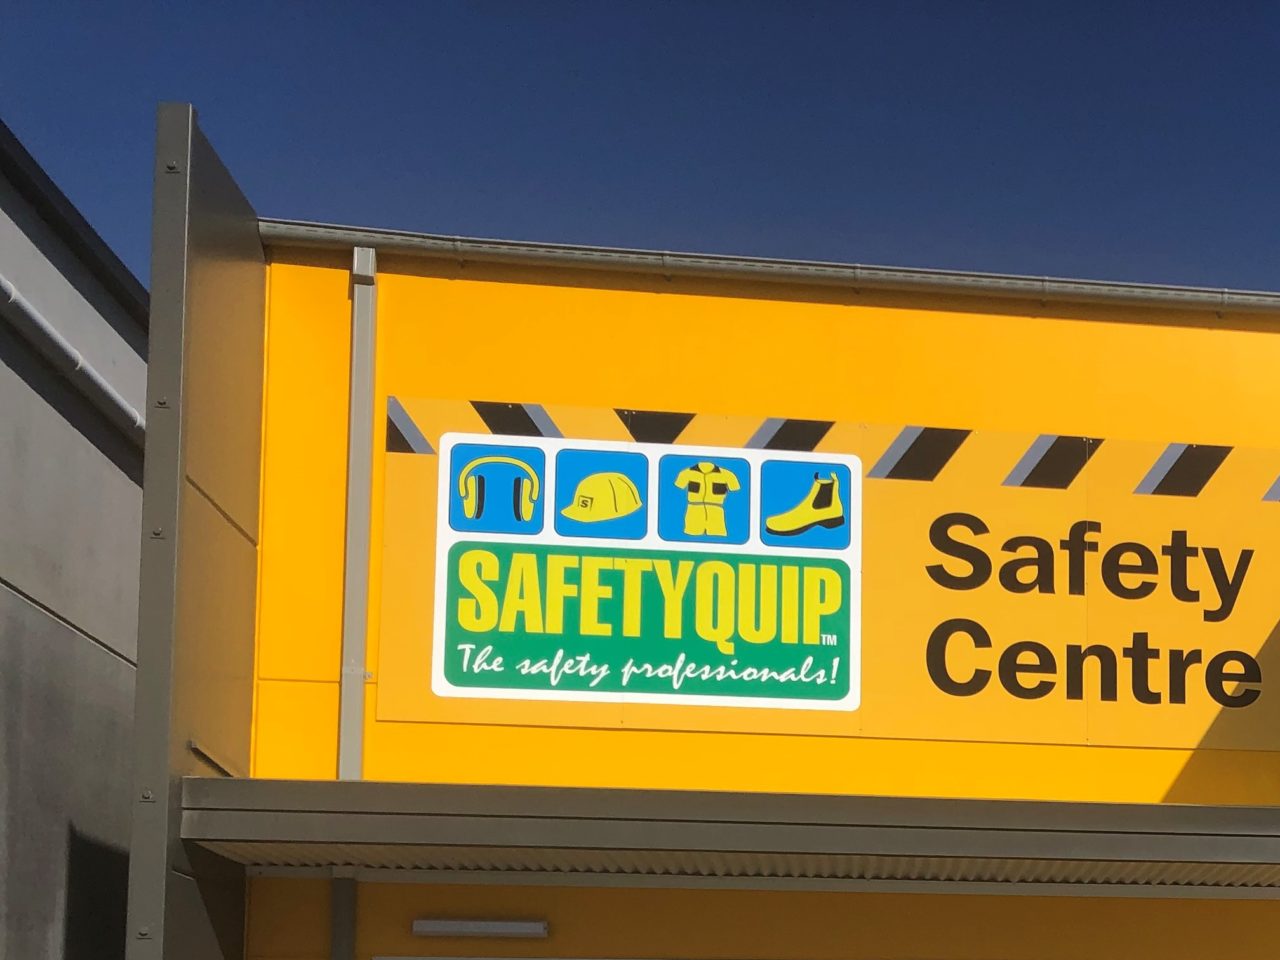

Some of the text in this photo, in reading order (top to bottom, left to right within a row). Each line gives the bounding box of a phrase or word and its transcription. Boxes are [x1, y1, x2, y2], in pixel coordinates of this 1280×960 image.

[457, 549, 843, 655] SAFETYQUIP
[925, 512, 1255, 623] Safety
[457, 644, 841, 690] The safety professionals!
[926, 618, 1262, 708] Centre
